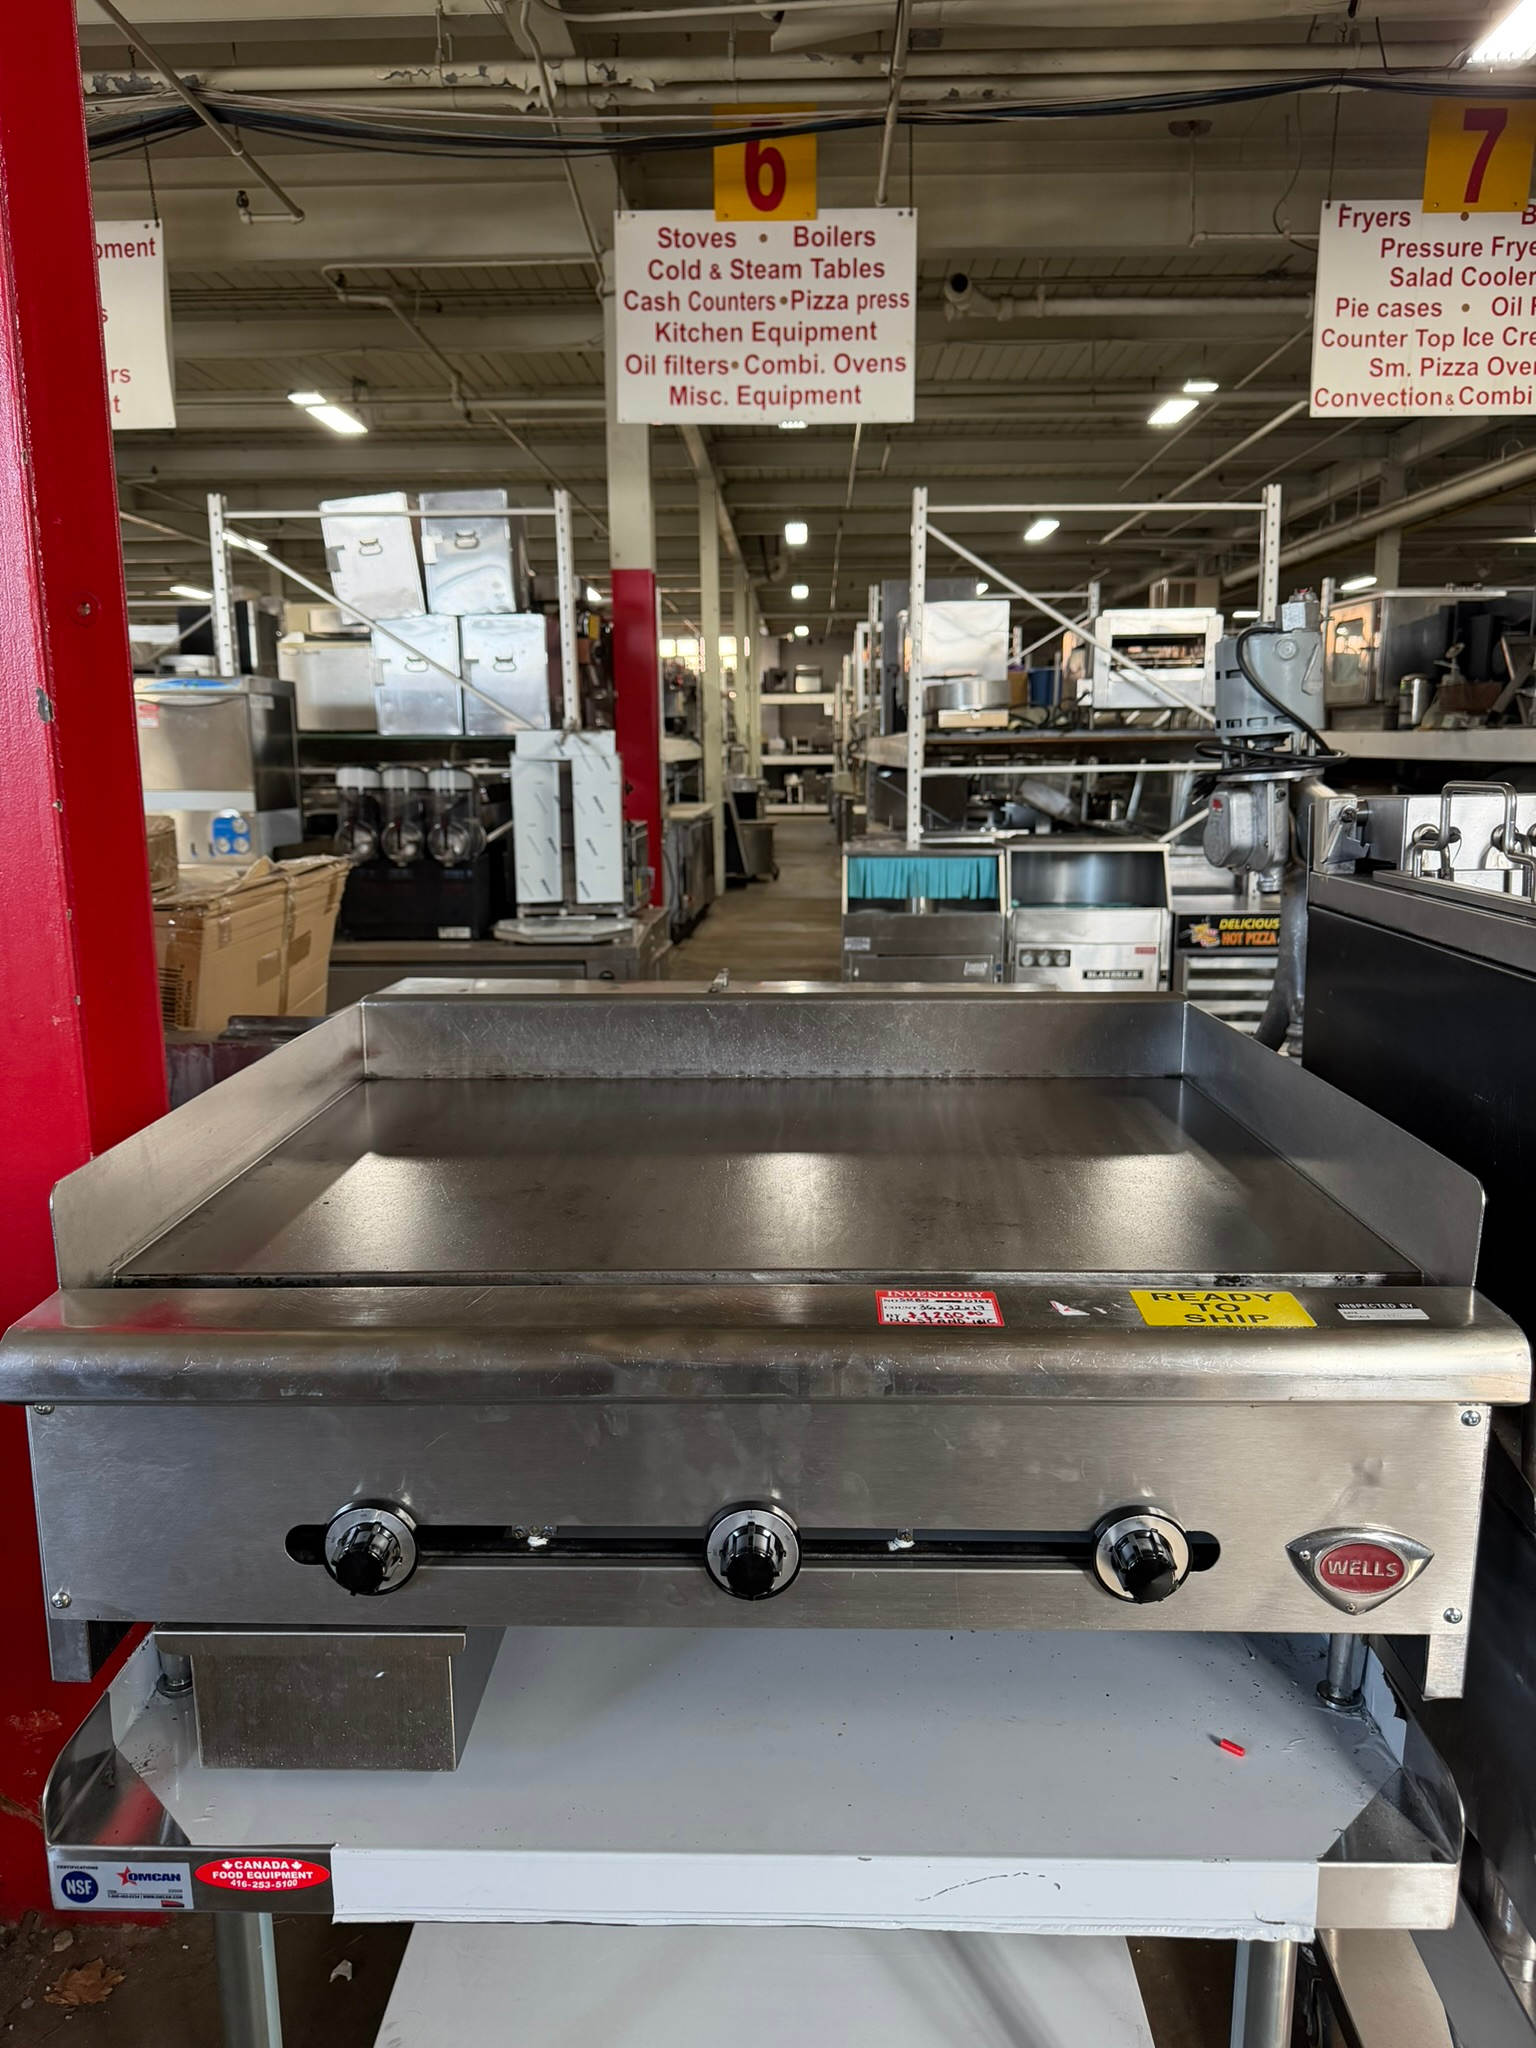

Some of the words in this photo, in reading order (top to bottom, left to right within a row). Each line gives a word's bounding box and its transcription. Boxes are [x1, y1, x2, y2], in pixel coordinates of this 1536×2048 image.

[1463, 107, 1508, 203] 7
[744, 120, 787, 212] 6
[1338, 207, 1411, 234] Fryers
[657, 227, 737, 249] Stoves
[793, 226, 876, 247] Boilers
[1380, 237, 1483, 258] Pressure
[648, 259, 701, 281] Cold
[709, 264, 722, 280] &
[730, 258, 802, 280] Steam
[811, 257, 885, 279] Tables
[1390, 267, 1453, 288] Salad
[624, 290, 680, 312] Cash
[688, 291, 776, 312] Counters
[791, 290, 849, 311] Pizza
[856, 291, 910, 315] press
[1336, 298, 1368, 318] Pie
[1377, 300, 1442, 317] cases
[1491, 296, 1522, 317] Oil
[655, 321, 743, 343] Kitchen
[752, 321, 877, 346] Equipment
[1321, 329, 1407, 348] Counter
[1415, 328, 1454, 352] Top
[1463, 327, 1494, 347] Ice
[625, 354, 656, 376] Oil
[664, 354, 730, 375] filters
[744, 353, 825, 375] Combi.
[834, 353, 906, 373] Ovens
[1369, 358, 1411, 378] Sm.
[1420, 357, 1479, 377] Pizza
[669, 386, 728, 407] Misc.
[737, 384, 862, 410] Equipment
[1315, 387, 1443, 408] Convection
[1445, 393, 1455, 406] &
[1459, 386, 1533, 406] Combi
[1219, 918, 1280, 930] DELICIOUS
[1221, 932, 1244, 945] HOT
[1245, 931, 1277, 945] PIZZA
[888, 1290, 984, 1298] INVENTORY
[1151, 1293, 1273, 1302] READY
[1190, 1303, 1241, 1312] TO
[1184, 1313, 1269, 1324] SHIP
[1328, 1560, 1398, 1577] WELLS
[212, 1871, 244, 1879] FOOD
[247, 1871, 313, 1879] EQUIPMENT
[234, 1861, 289, 1870] CANADA
[65, 1880, 92, 1895] NSF
[128, 1873, 181, 1882] OMCAN
[230, 1879, 298, 1889] 416-253-5100
